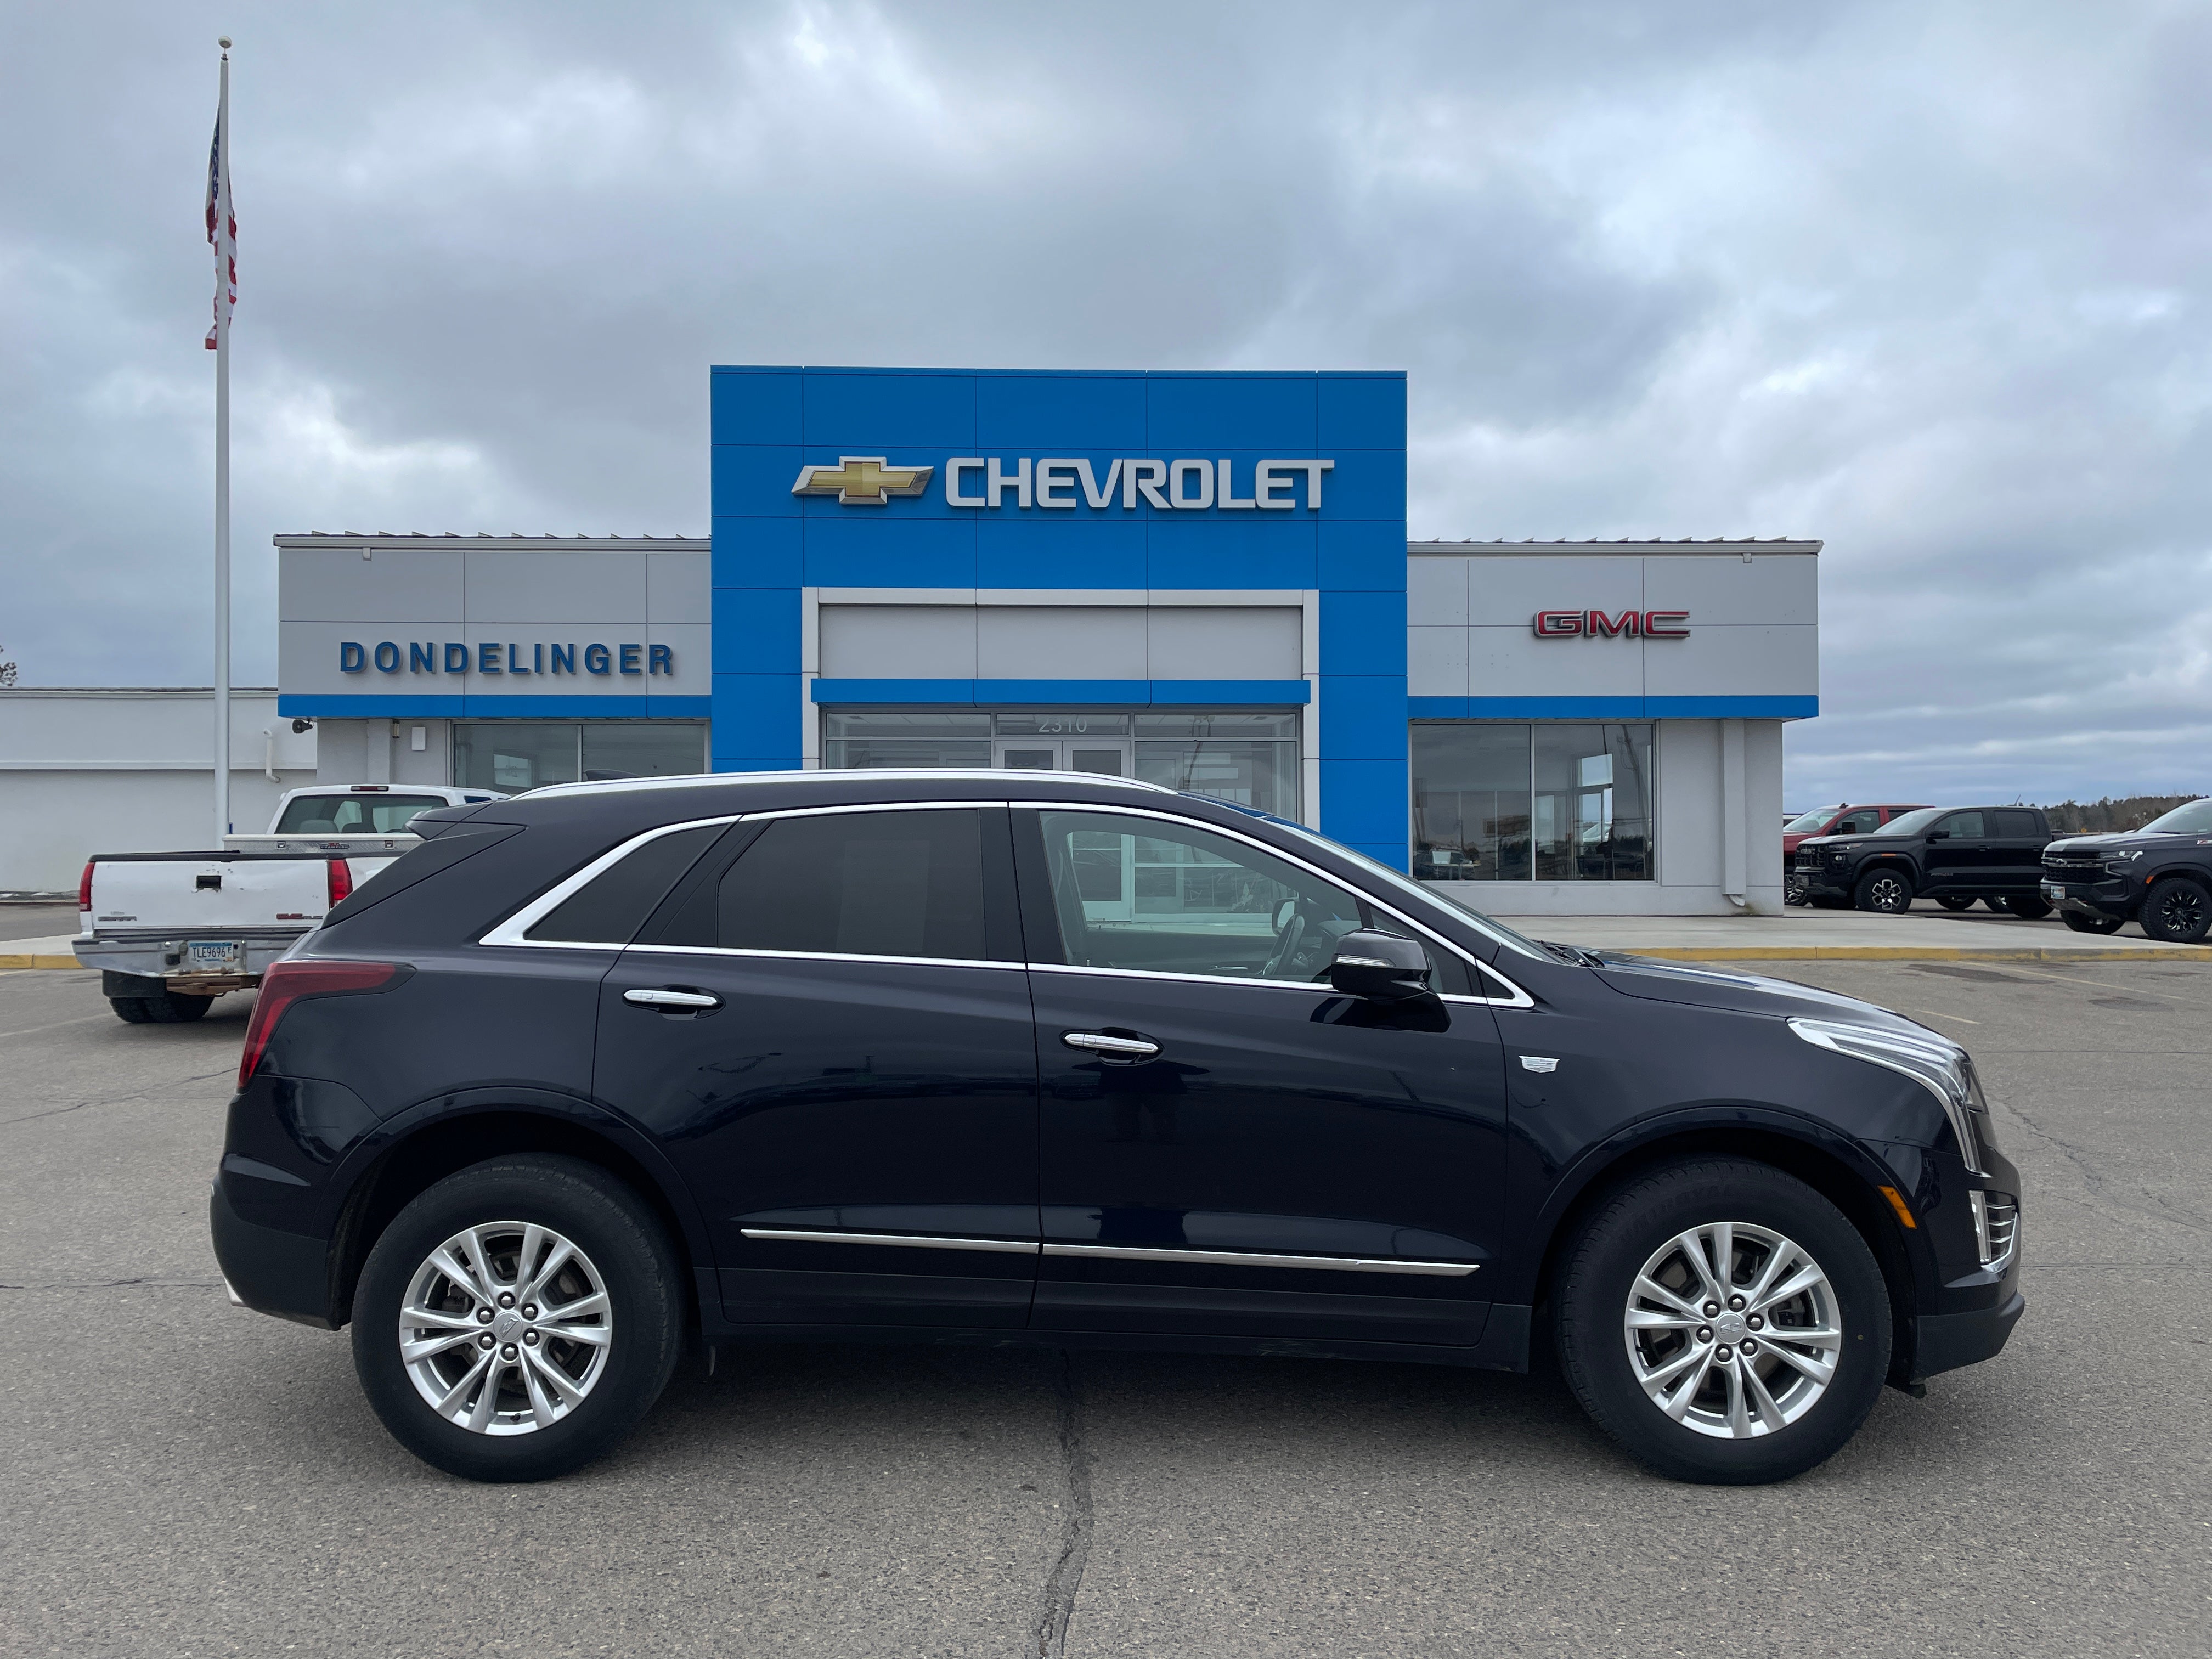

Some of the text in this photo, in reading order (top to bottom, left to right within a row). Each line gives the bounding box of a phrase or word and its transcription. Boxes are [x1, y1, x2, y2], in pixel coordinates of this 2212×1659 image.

[945, 457, 1335, 509] CHEVROLET
[1533, 609, 1691, 638] GMC
[340, 641, 674, 675] DONDELINGER
[1038, 716, 1088, 733] 2310
[193, 947, 225, 958] TLE9696
